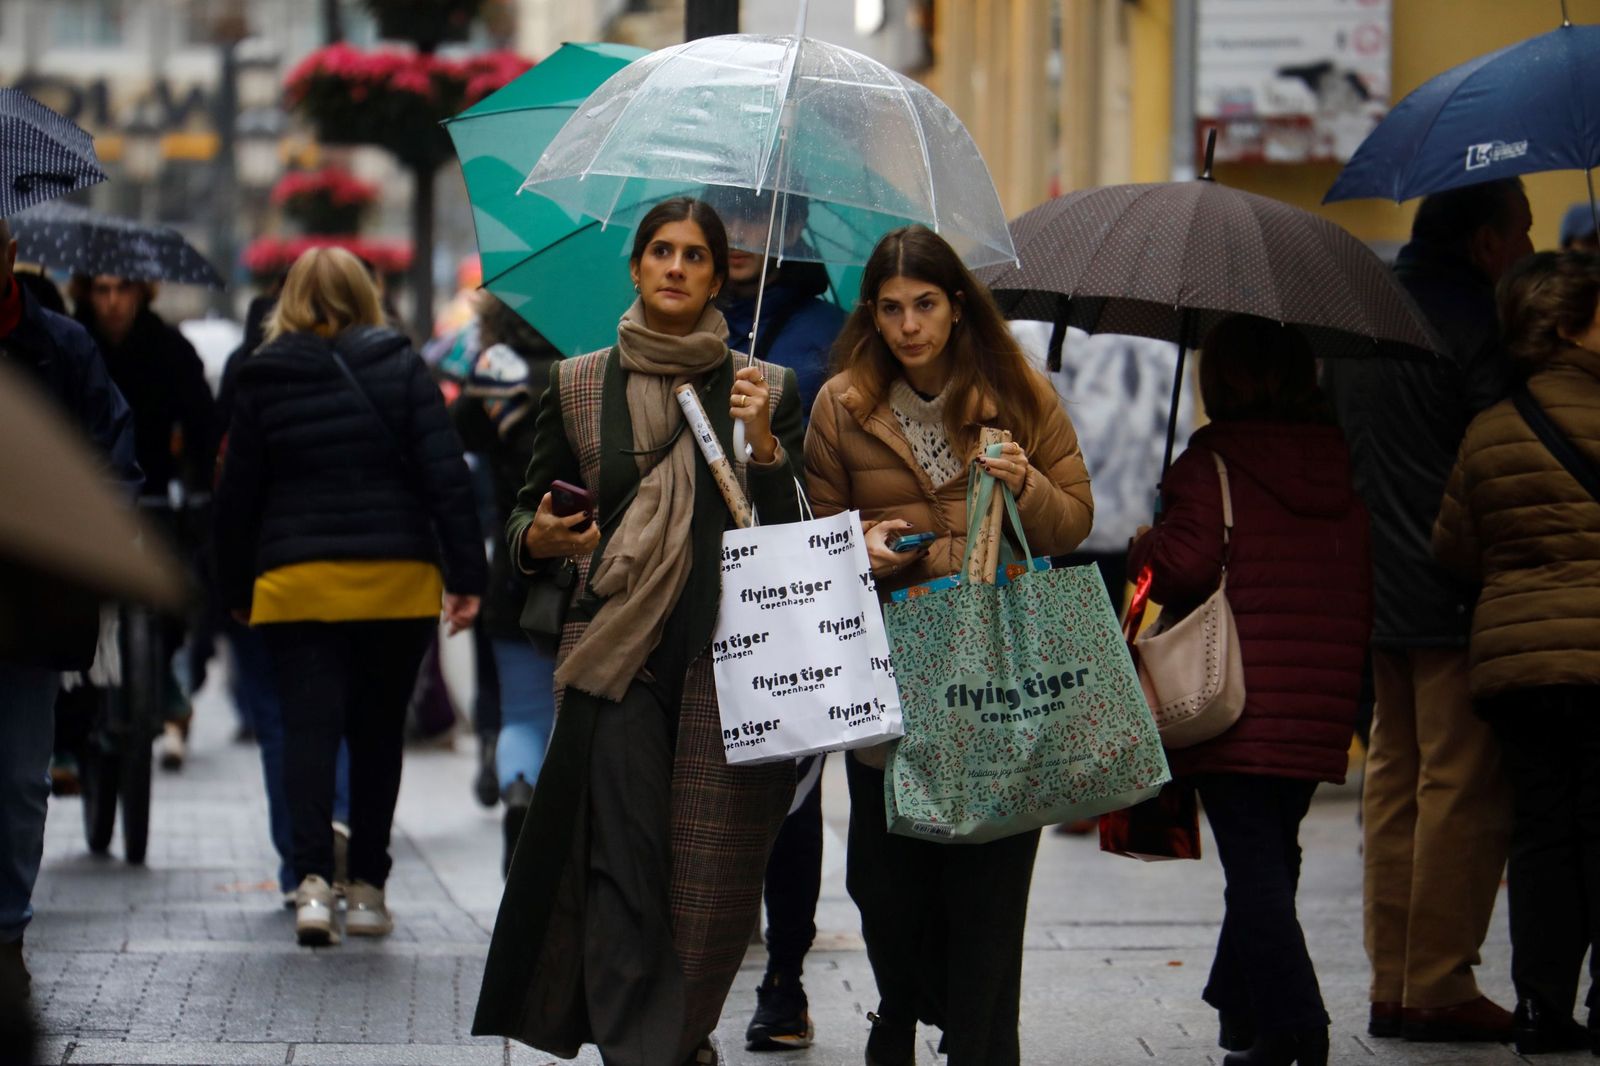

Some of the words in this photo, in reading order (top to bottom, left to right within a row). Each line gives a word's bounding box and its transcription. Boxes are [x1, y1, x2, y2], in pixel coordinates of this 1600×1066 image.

[808, 530, 849, 549] flying
[740, 586, 788, 604] flying
[790, 580, 832, 597] tiger
[760, 597, 815, 610] copenhagen
[818, 615, 861, 635] flying
[729, 632, 769, 649] tiger
[752, 673, 798, 691] flying
[800, 665, 842, 682] tiger
[772, 683, 825, 697] copenhagen
[945, 680, 1022, 711] flying
[1023, 667, 1089, 699] tiger
[828, 702, 871, 721] flying
[980, 700, 1065, 724] copenhagen
[741, 719, 780, 736] tiger
[967, 770, 998, 780] Holiday
